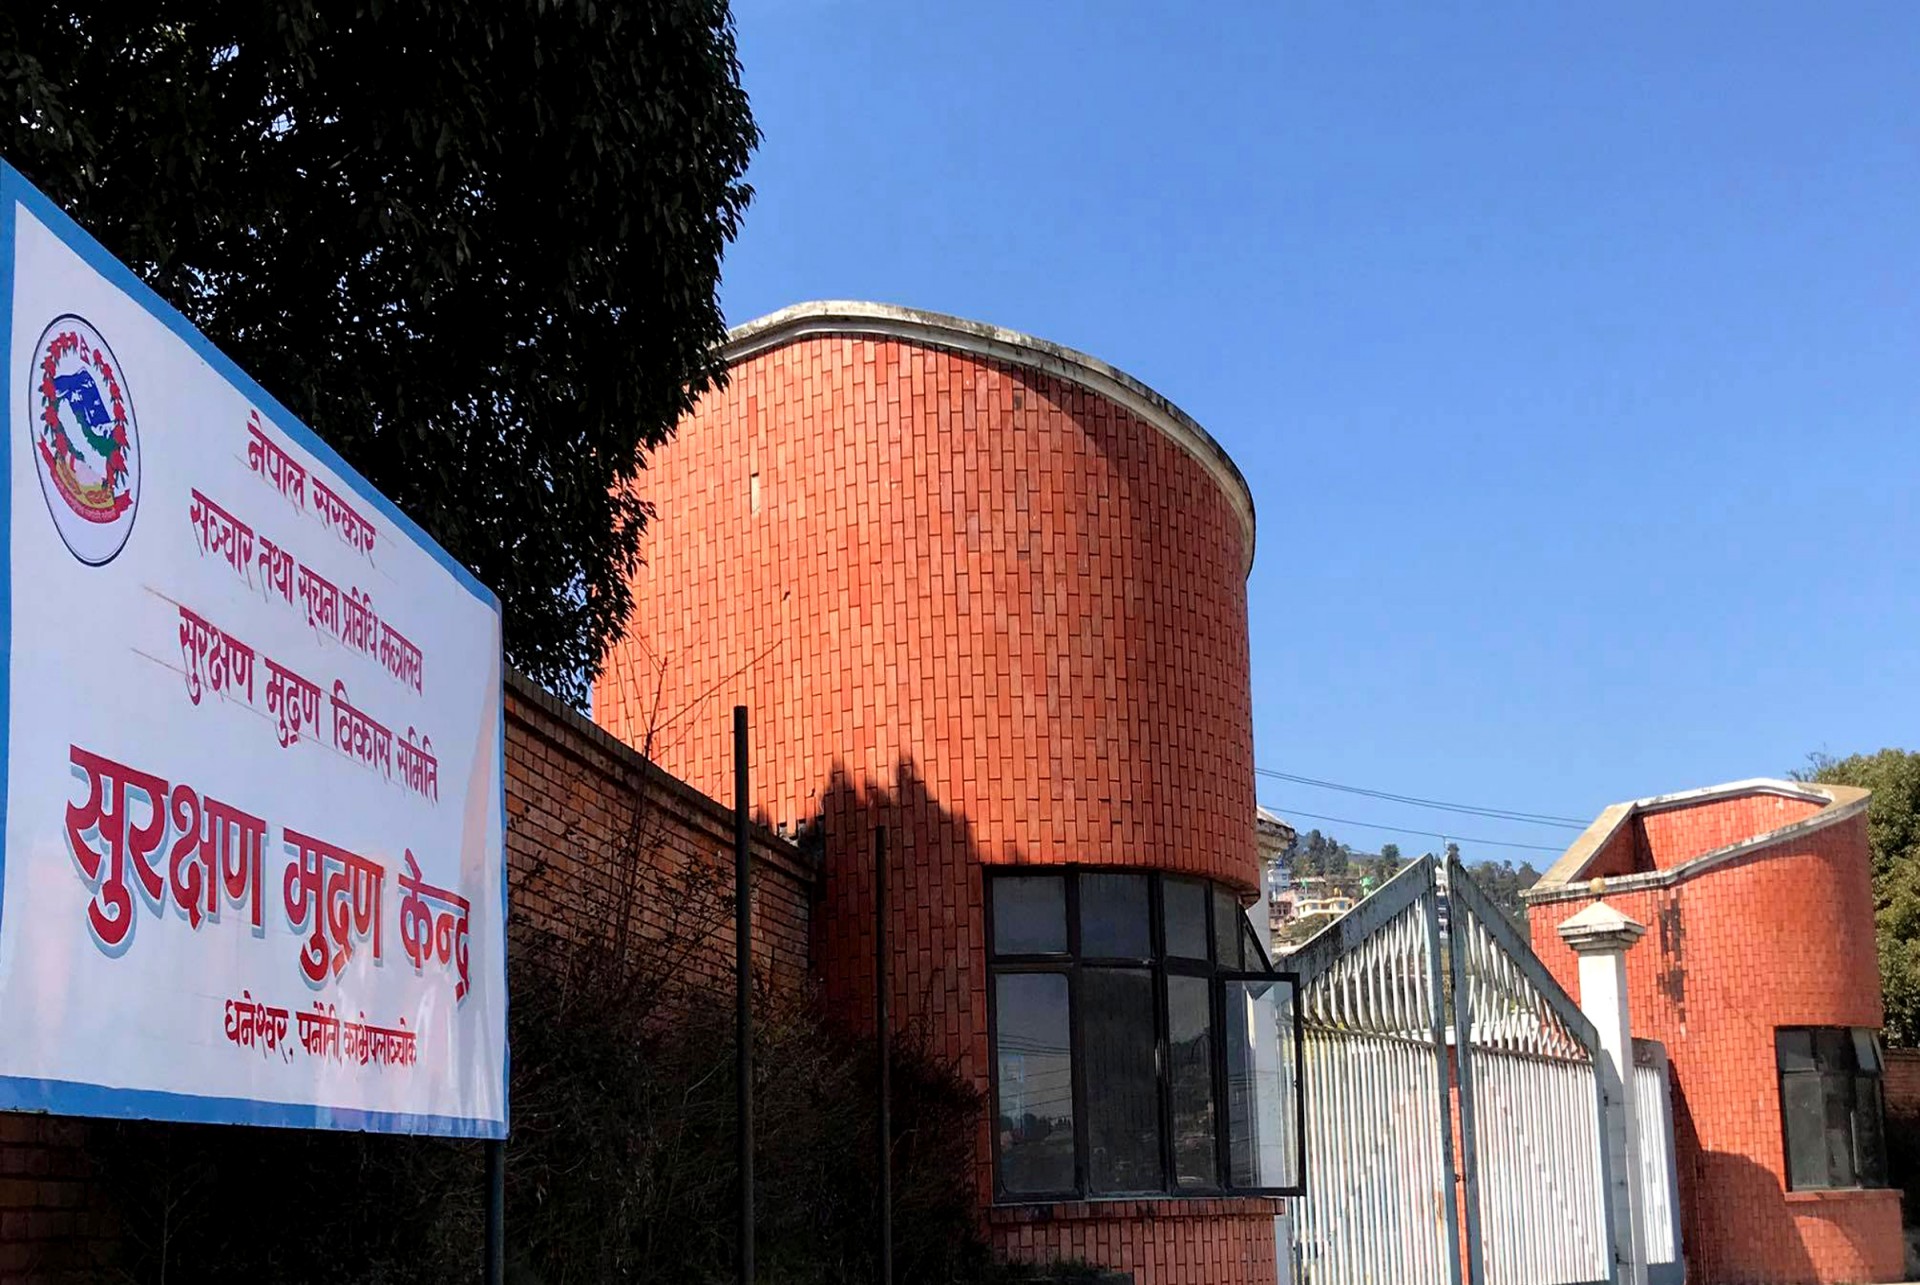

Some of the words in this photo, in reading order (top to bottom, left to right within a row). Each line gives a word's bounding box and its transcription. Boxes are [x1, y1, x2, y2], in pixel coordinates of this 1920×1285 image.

[247, 410, 306, 515] नेपाल
[312, 476, 376, 568] सरकार
[259, 535, 295, 606] तथा
[298, 563, 339, 647] सूचना
[341, 586, 379, 661] प्रविधि
[179, 605, 255, 706] सुरक्षण
[264, 657, 322, 748] मुद्रण
[330, 679, 392, 785] विकास
[397, 726, 438, 806] समिति
[66, 744, 267, 945] सुरक्षण
[283, 827, 385, 982] मुद्रण
[398, 848, 471, 1003] केन्द्र
